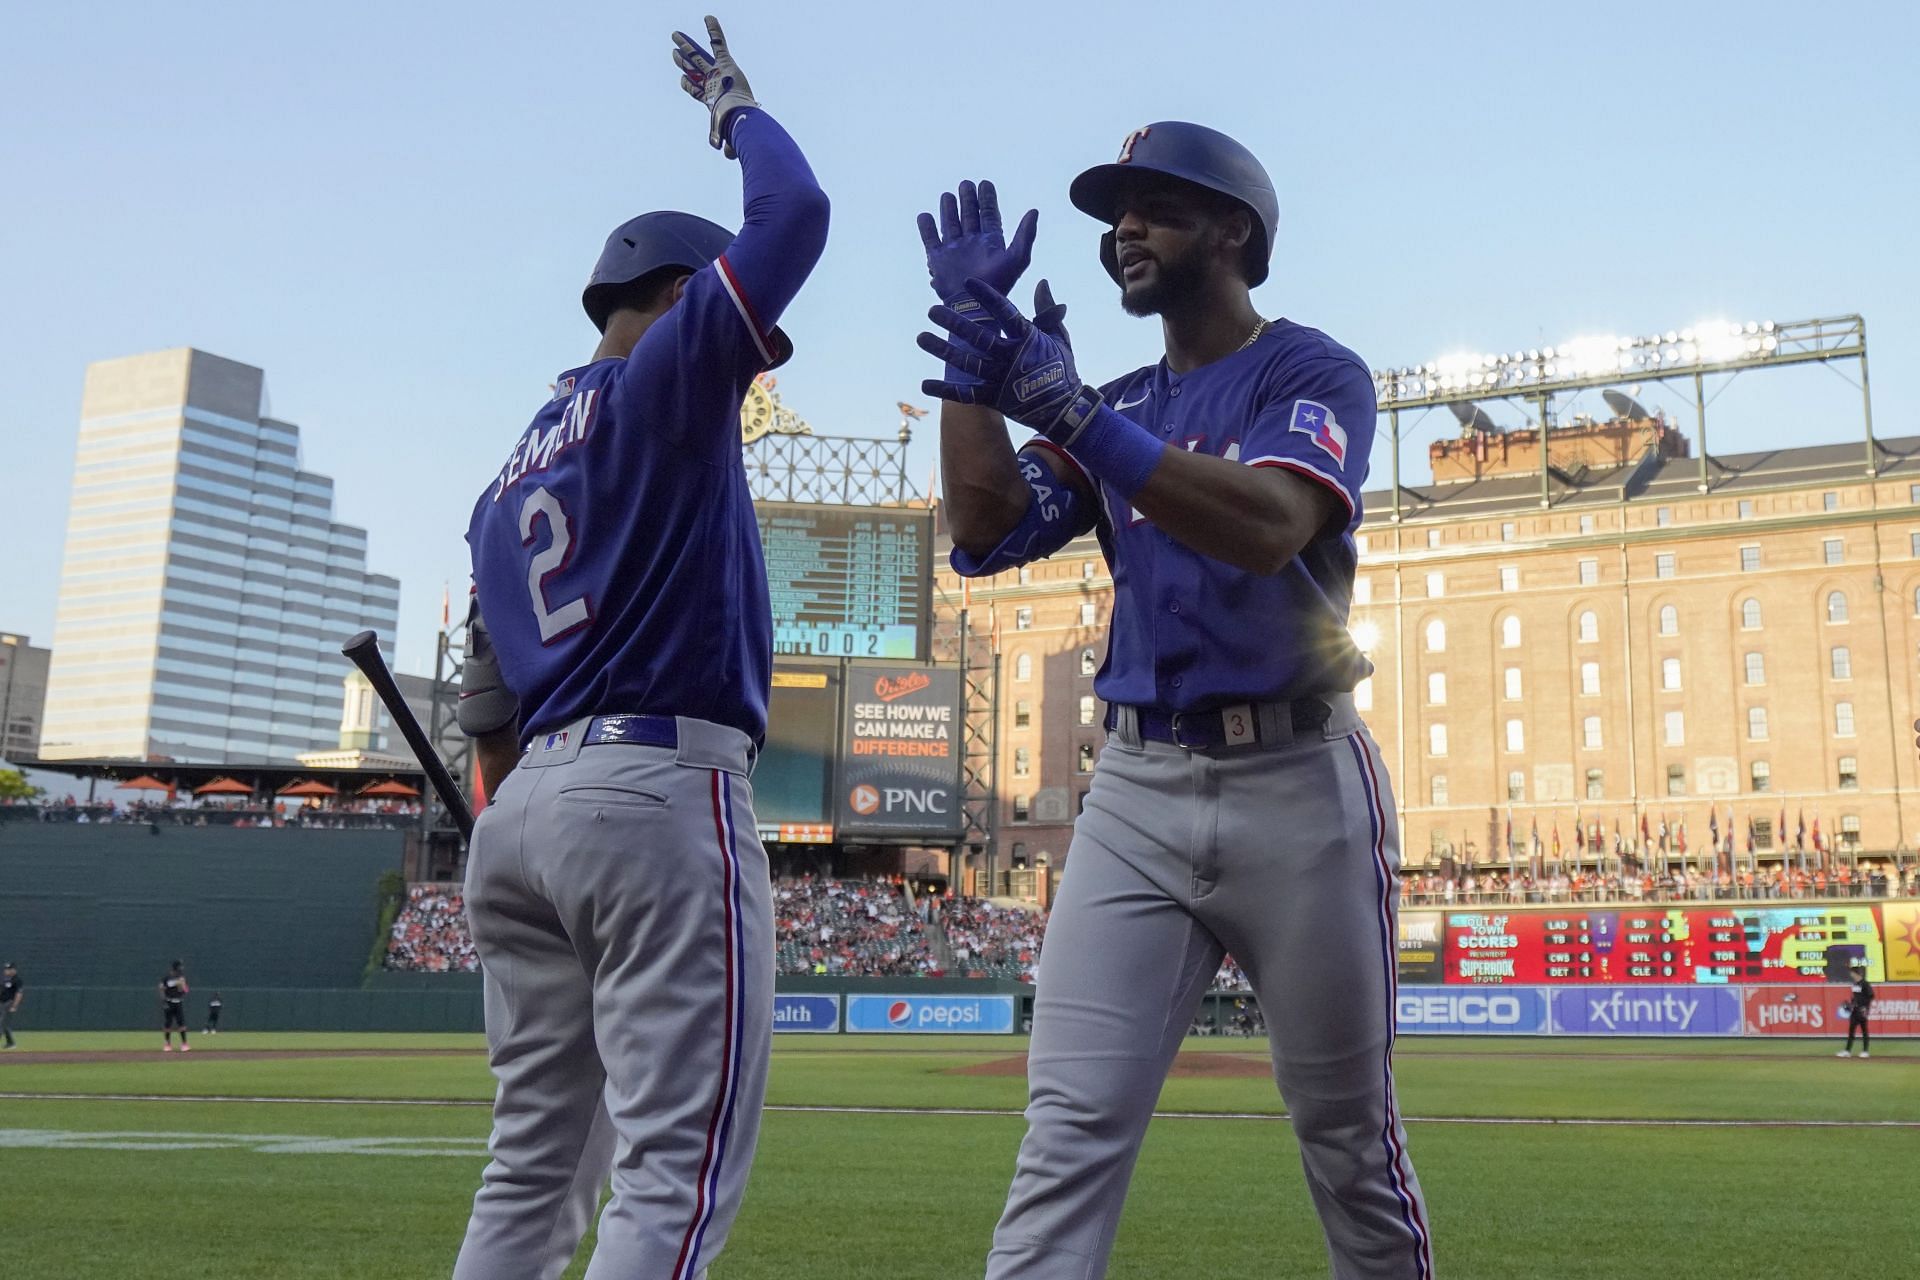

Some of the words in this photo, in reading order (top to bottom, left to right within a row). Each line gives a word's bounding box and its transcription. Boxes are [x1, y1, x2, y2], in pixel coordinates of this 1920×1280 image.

[1117, 127, 1151, 164] T
[518, 484, 596, 648] 2
[819, 632, 829, 653] 0
[844, 633, 853, 654] 0
[868, 634, 878, 655] 2
[854, 703, 884, 719] SEE
[887, 704, 923, 720] HOW
[925, 706, 951, 721] WE
[854, 721, 887, 737] CAN
[890, 722, 934, 738] MAKE
[936, 724, 948, 739] A
[1229, 714, 1245, 736] 3
[853, 740, 949, 756] DIFFERENCE
[882, 789, 947, 814] PNC
[1467, 916, 1489, 926] OUT
[1493, 916, 1508, 926] OF
[1547, 920, 1568, 930] LAD
[1712, 919, 1735, 928] WAS
[1471, 926, 1505, 936] TOWN
[1579, 934, 1589, 944] 4
[1458, 935, 1518, 948] SCORES
[1549, 953, 1570, 962] CWS
[1580, 952, 1590, 962] 4
[1632, 953, 1650, 962] STL
[1715, 952, 1735, 961] TOR
[1800, 951, 1823, 959] HOU
[1460, 959, 1515, 977] SUPERBOOK
[1551, 968, 1569, 977] DET
[1632, 967, 1650, 976] CLE
[919, 1003, 980, 1027] pepsi
[1397, 996, 1520, 1024] GEICO
[1590, 991, 1699, 1030] xfinity
[1759, 1003, 1824, 1028] HIGH'S
